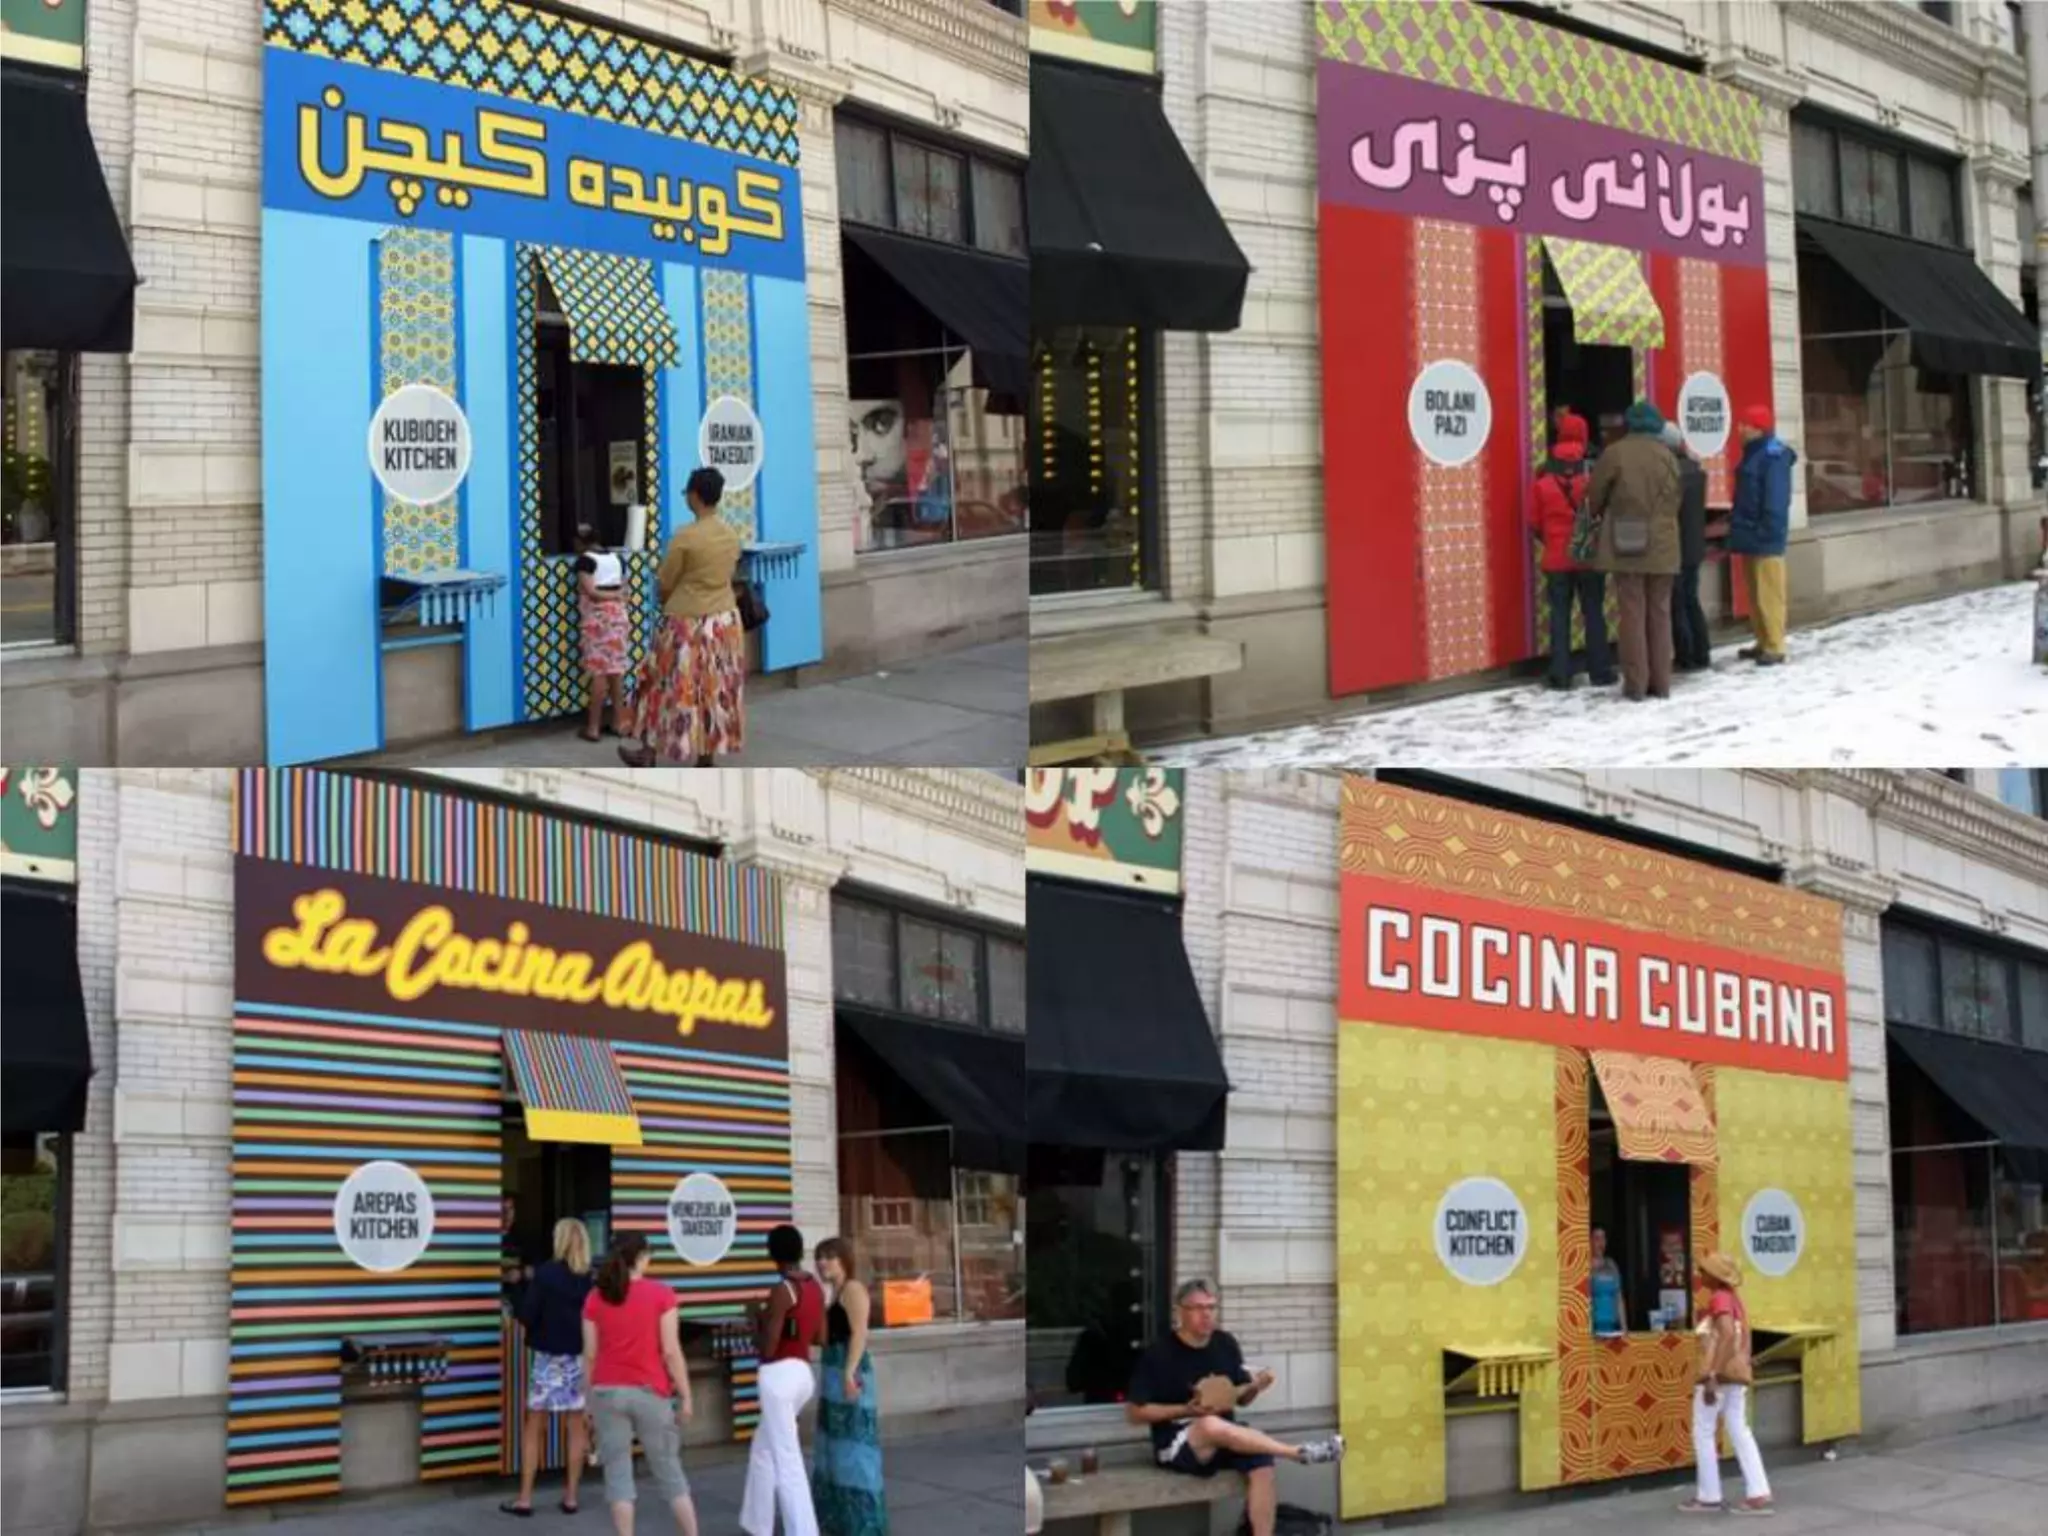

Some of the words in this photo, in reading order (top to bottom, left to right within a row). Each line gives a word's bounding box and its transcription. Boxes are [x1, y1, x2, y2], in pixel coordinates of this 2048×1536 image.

[298, 84, 548, 216] کیچن
[1349, 116, 1529, 223] پزی
[568, 156, 785, 255] کوبیده
[1549, 150, 1751, 247] بولانی
[1425, 390, 1476, 412] BOLANI
[383, 418, 457, 442] KUBIDEH
[1434, 415, 1468, 436] PAZI
[384, 447, 457, 470] KITCHEN
[708, 445, 754, 465] TAKEOUT
[262, 888, 386, 976] La
[386, 905, 604, 1003] Cocina
[602, 940, 775, 1036] Arepas
[1366, 905, 1621, 1021] COCINA
[1638, 955, 1836, 1054] CUBANA
[353, 1190, 417, 1214] AREPAS
[350, 1217, 418, 1239] KITCHEN
[1445, 1209, 1518, 1231] CONFLICT
[1755, 1213, 1791, 1233] CUBAN
[1450, 1235, 1515, 1256] KITCHEN
[1750, 1234, 1796, 1254] TAKEOUT
